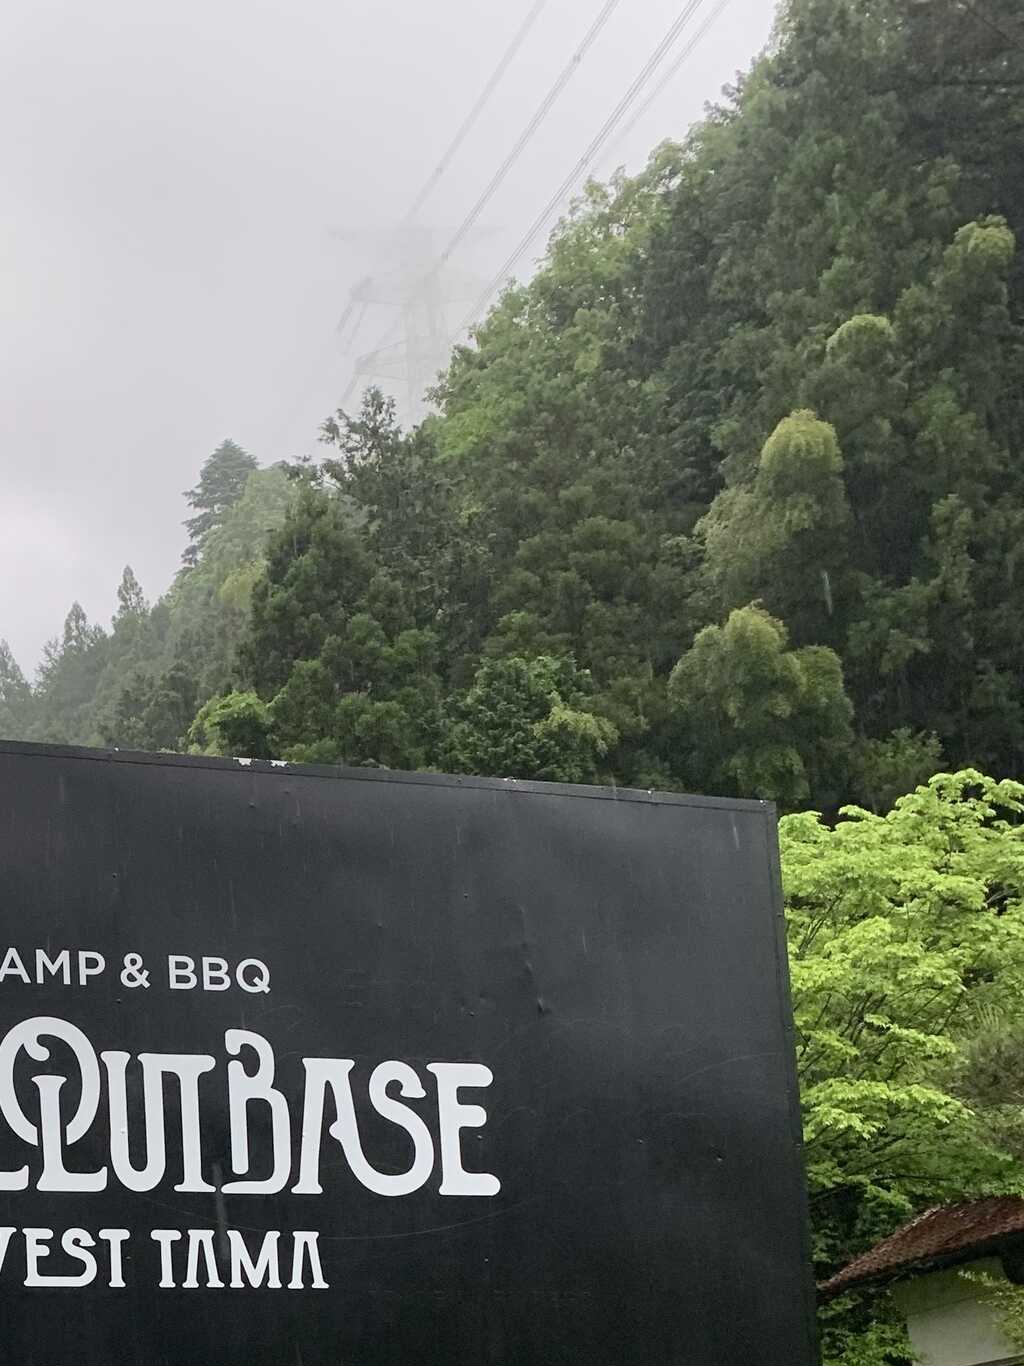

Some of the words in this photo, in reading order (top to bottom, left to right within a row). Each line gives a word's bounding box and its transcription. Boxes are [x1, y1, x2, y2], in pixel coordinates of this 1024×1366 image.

[120, 952, 151, 989] &
[168, 954, 271, 995] BBQ
[150, 1229, 330, 1290] TAMA
